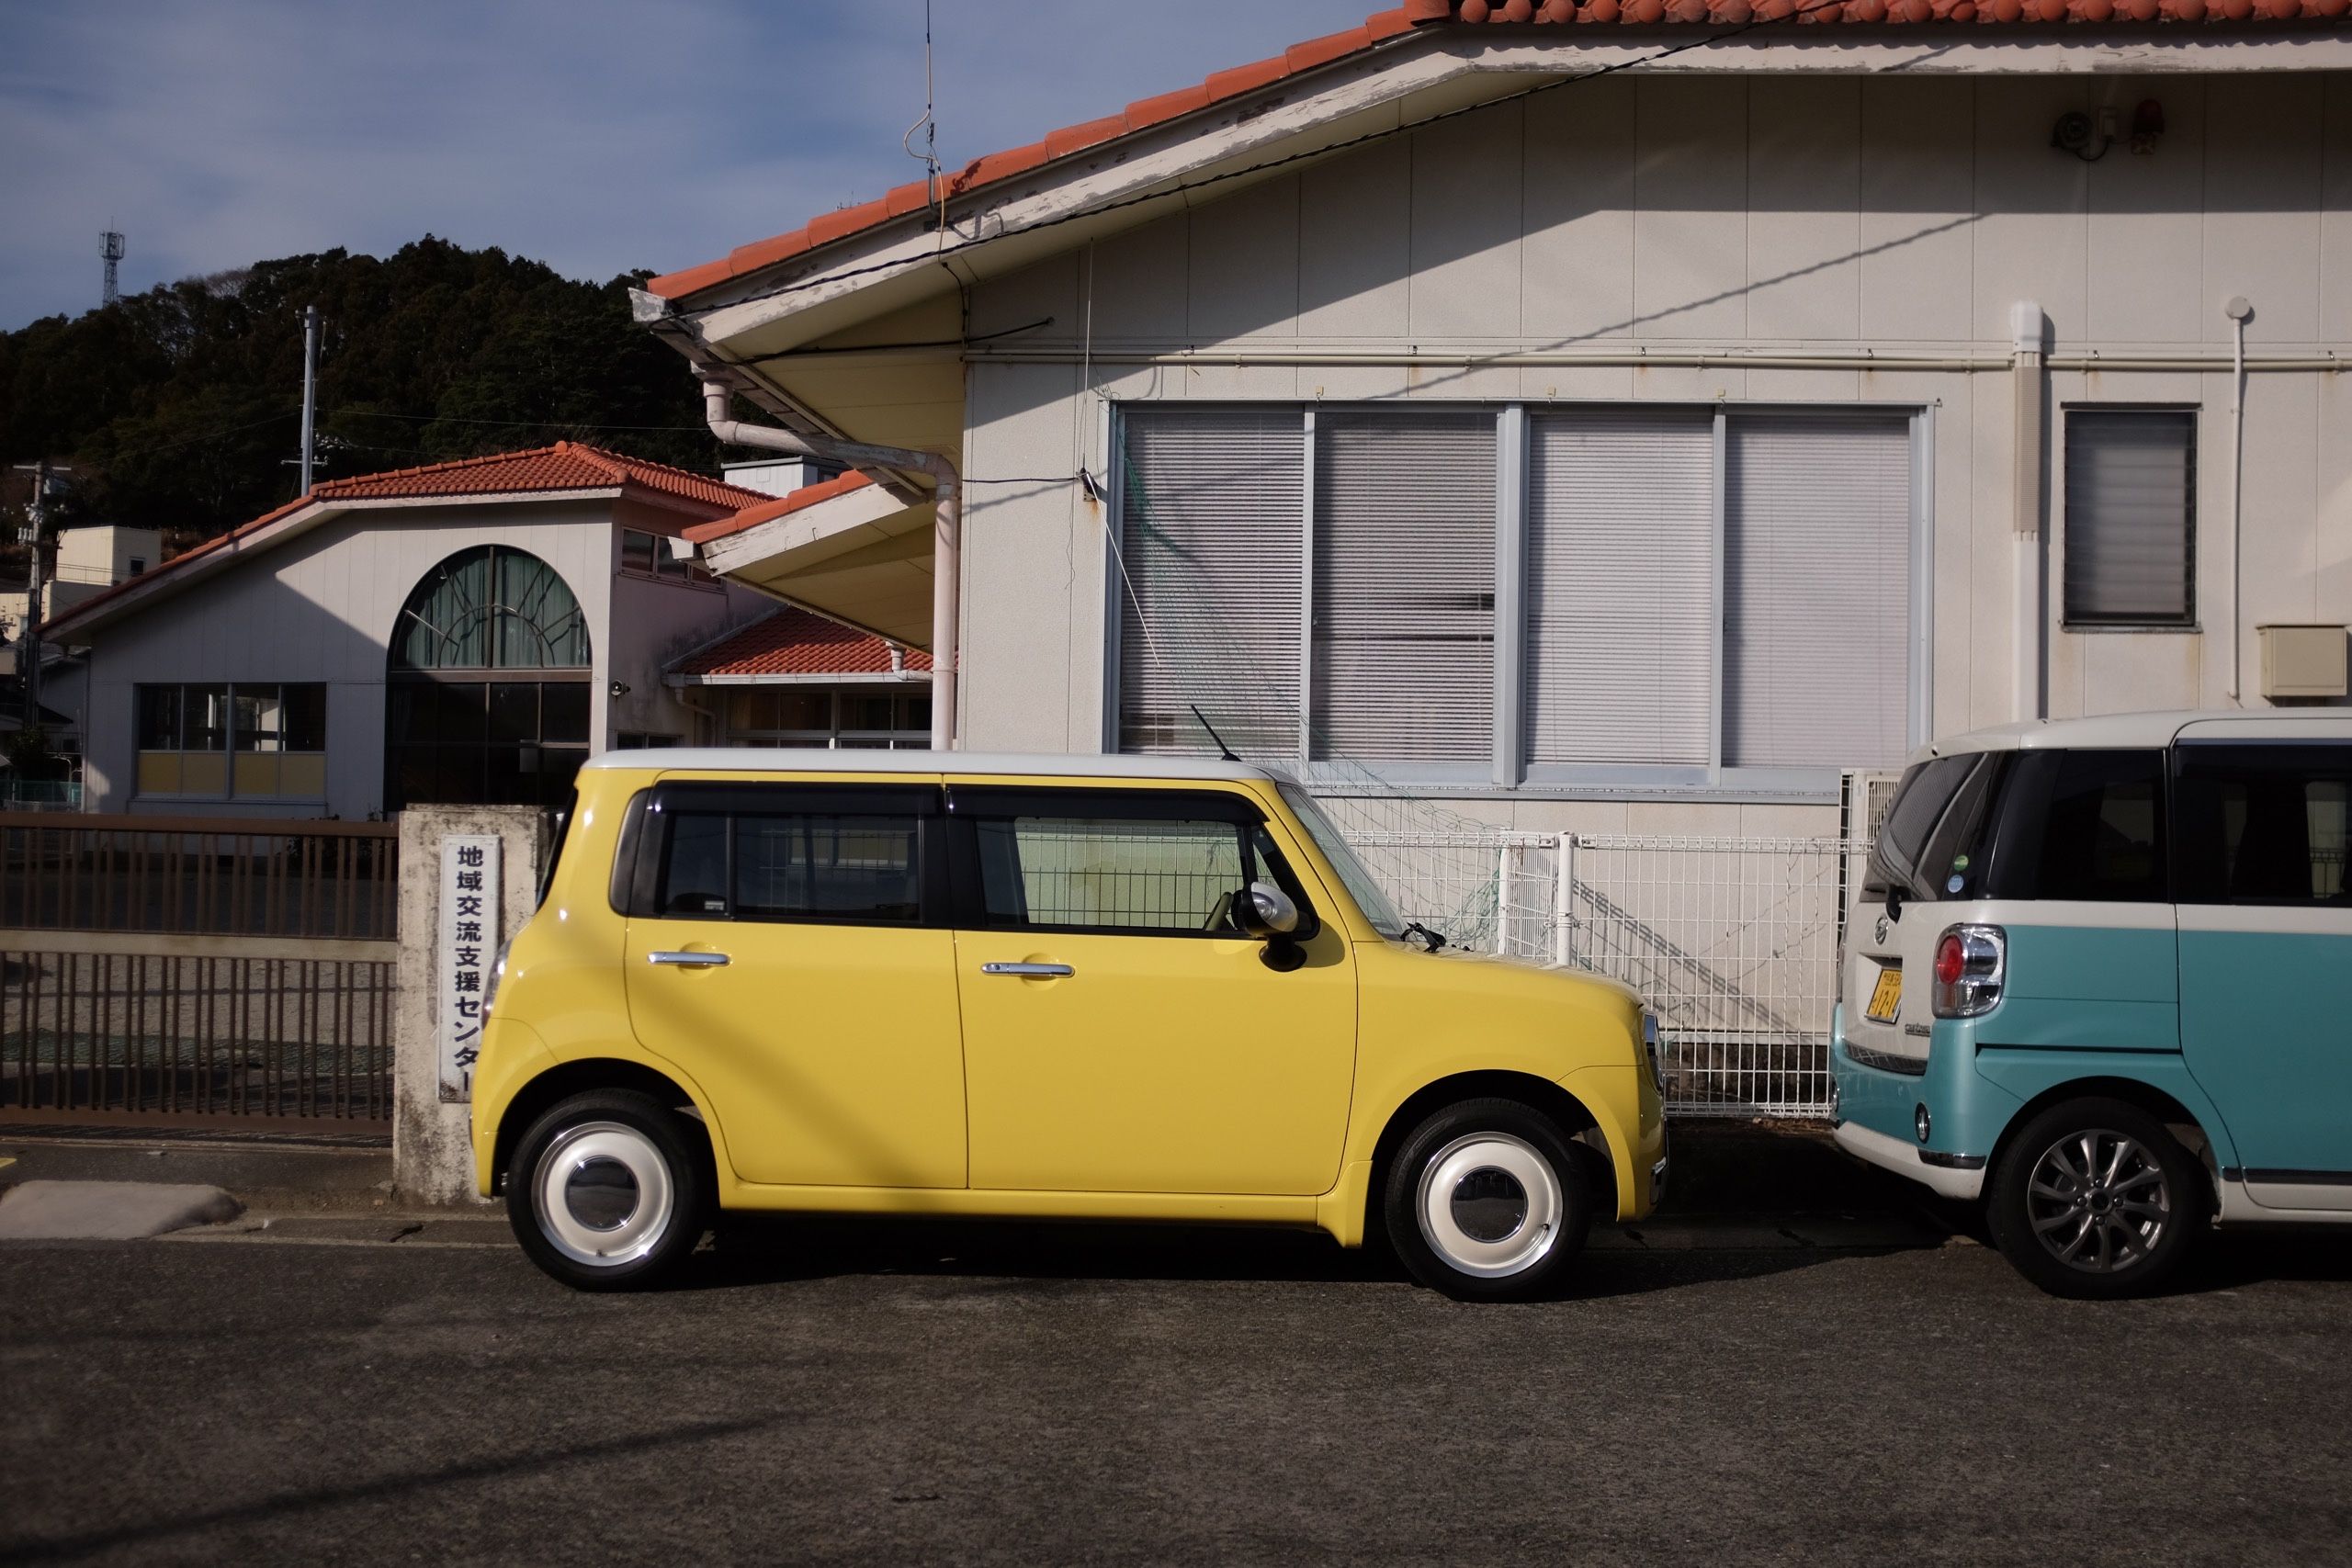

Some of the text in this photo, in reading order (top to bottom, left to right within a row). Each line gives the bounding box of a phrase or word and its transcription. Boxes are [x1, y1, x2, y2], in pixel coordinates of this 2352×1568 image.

[454, 845, 483, 1092] 地域交流支援センター
